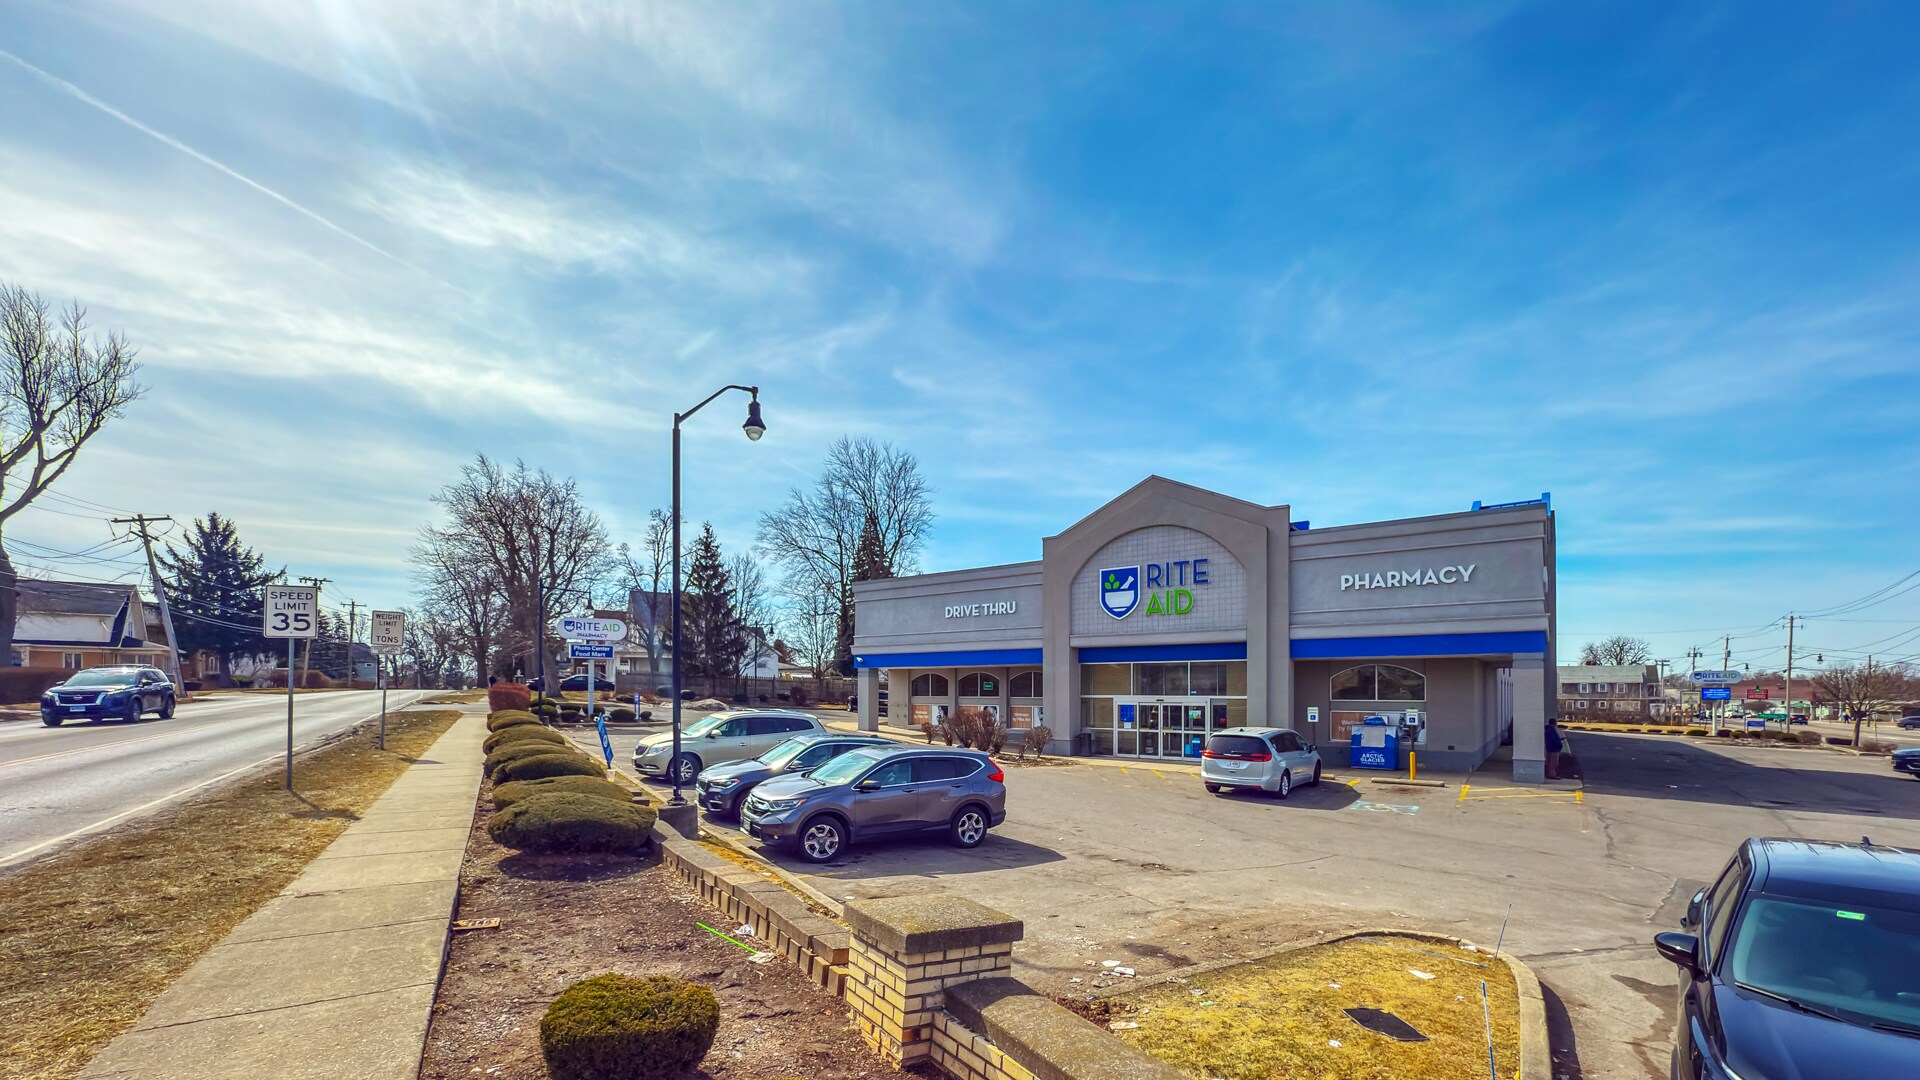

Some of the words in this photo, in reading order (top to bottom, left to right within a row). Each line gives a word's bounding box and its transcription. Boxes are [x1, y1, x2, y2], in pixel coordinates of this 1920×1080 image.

[1147, 559, 1209, 588] RITE
[1340, 564, 1476, 591] PHARMACY
[270, 591, 314, 600] SPEED
[274, 602, 309, 611] LIMIT
[1145, 589, 1194, 616] AID
[945, 604, 980, 618] DRIVE
[981, 601, 1016, 616] THRU
[271, 612, 311, 632] 35
[375, 613, 402, 621] WEIGHT
[384, 627, 391, 635] 5
[575, 622, 600, 631] RITE
[602, 623, 620, 632] AID
[375, 635, 399, 644] TONS
